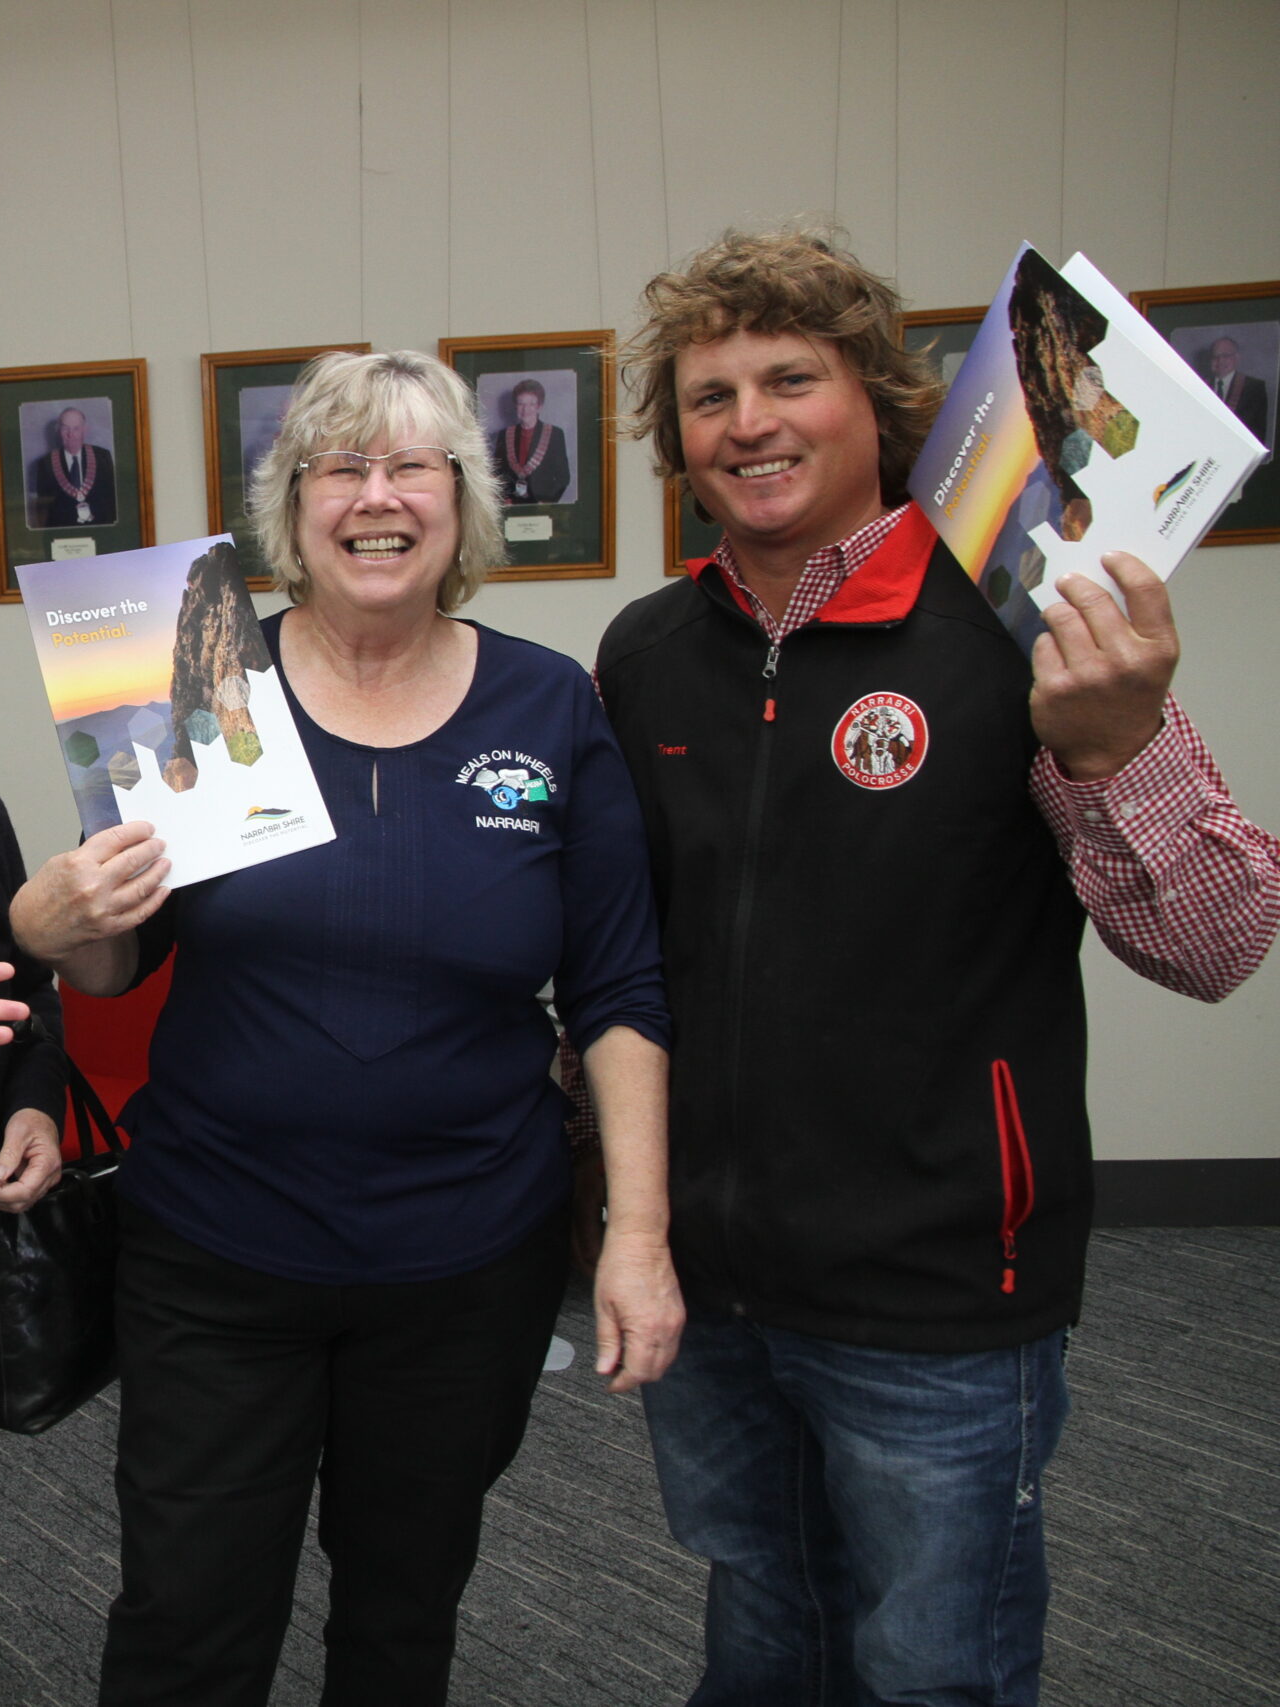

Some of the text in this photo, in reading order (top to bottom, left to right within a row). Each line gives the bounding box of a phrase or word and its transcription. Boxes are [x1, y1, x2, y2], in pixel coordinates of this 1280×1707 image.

[934, 392, 994, 507] Discover the
[45, 599, 148, 627] Discover the
[51, 621, 134, 648] Potential.
[850, 696, 916, 717] NARRABRI
[455, 749, 558, 793] MEALS ON WHEELS
[842, 763, 914, 785] POLOCROSSE
[240, 816, 305, 841] NARRABRI SHIRE
[475, 816, 540, 834] NARRABRI
